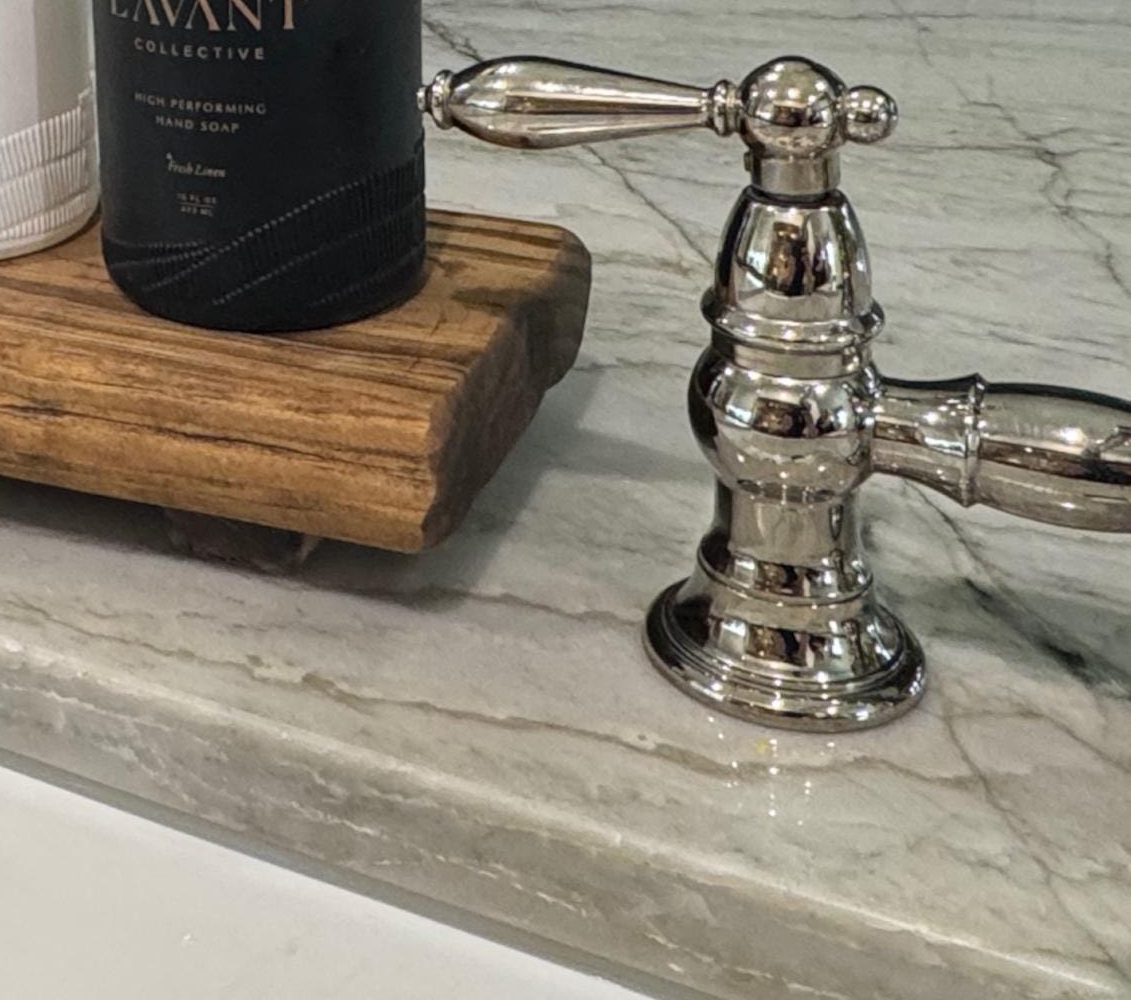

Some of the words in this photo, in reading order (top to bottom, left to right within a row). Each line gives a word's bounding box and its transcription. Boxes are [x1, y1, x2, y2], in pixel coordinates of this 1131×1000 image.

[134, 37, 265, 60] COLLECTIVE
[134, 91, 166, 108] HIGH
[170, 98, 267, 115] PERFORMING
[154, 115, 195, 131] HAND
[199, 120, 240, 134] SOAP
